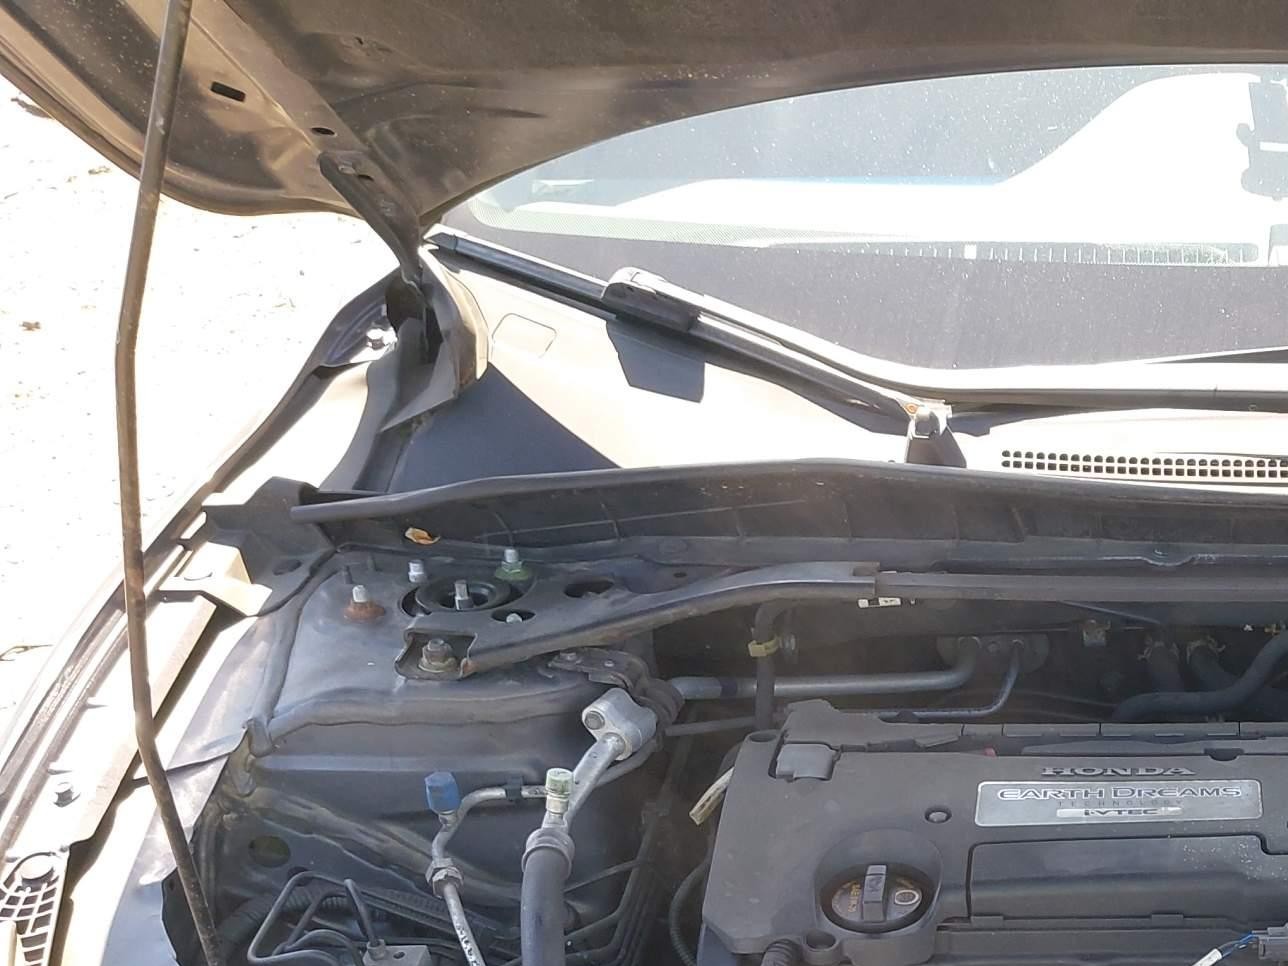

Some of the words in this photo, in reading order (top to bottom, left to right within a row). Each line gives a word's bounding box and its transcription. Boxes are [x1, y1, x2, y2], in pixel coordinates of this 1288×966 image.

[1041, 766, 1194, 776] HONDA
[997, 788, 1104, 800] EARTH
[1111, 786, 1241, 799] DREAMS
